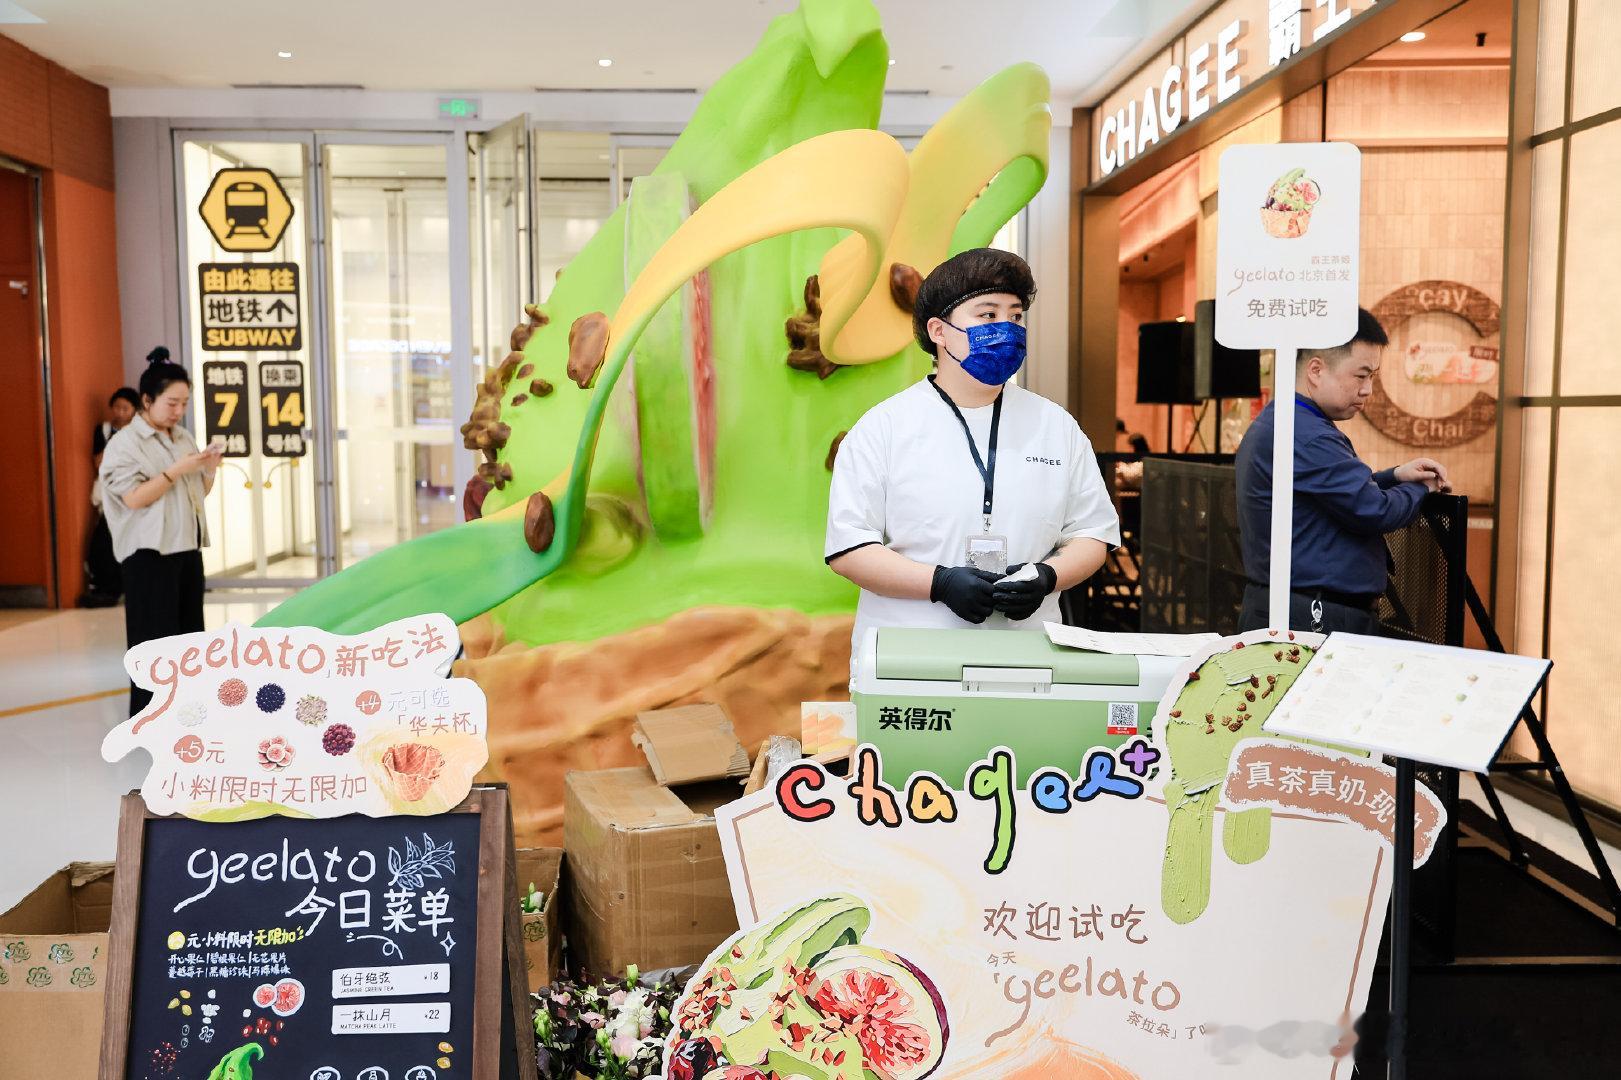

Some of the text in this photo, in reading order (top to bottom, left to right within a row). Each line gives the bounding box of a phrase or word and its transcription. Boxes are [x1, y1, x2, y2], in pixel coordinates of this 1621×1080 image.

[1099, 18, 1241, 175] CHAGEE
[203, 268, 295, 292] 由此通往
[1299, 268, 1351, 281] 北京首发
[208, 298, 262, 322] 地铁
[1247, 298, 1328, 318] 免费试吃
[206, 327, 296, 347] SUBWAY
[214, 392, 239, 427] 7
[262, 391, 304, 427] 14
[1026, 455, 1062, 466] CHAGEE
[161, 773, 367, 803] 小料限时无限加
[1245, 760, 1422, 834] 真茶真奶现
[173, 838, 377, 913] geelato
[285, 885, 454, 938] 今日菜单
[983, 900, 1149, 945] 欢迎试吃
[986, 950, 1017, 968] 今天
[340, 971, 391, 986] 伯牙绝弦
[340, 1008, 391, 1022] 一抹山月
